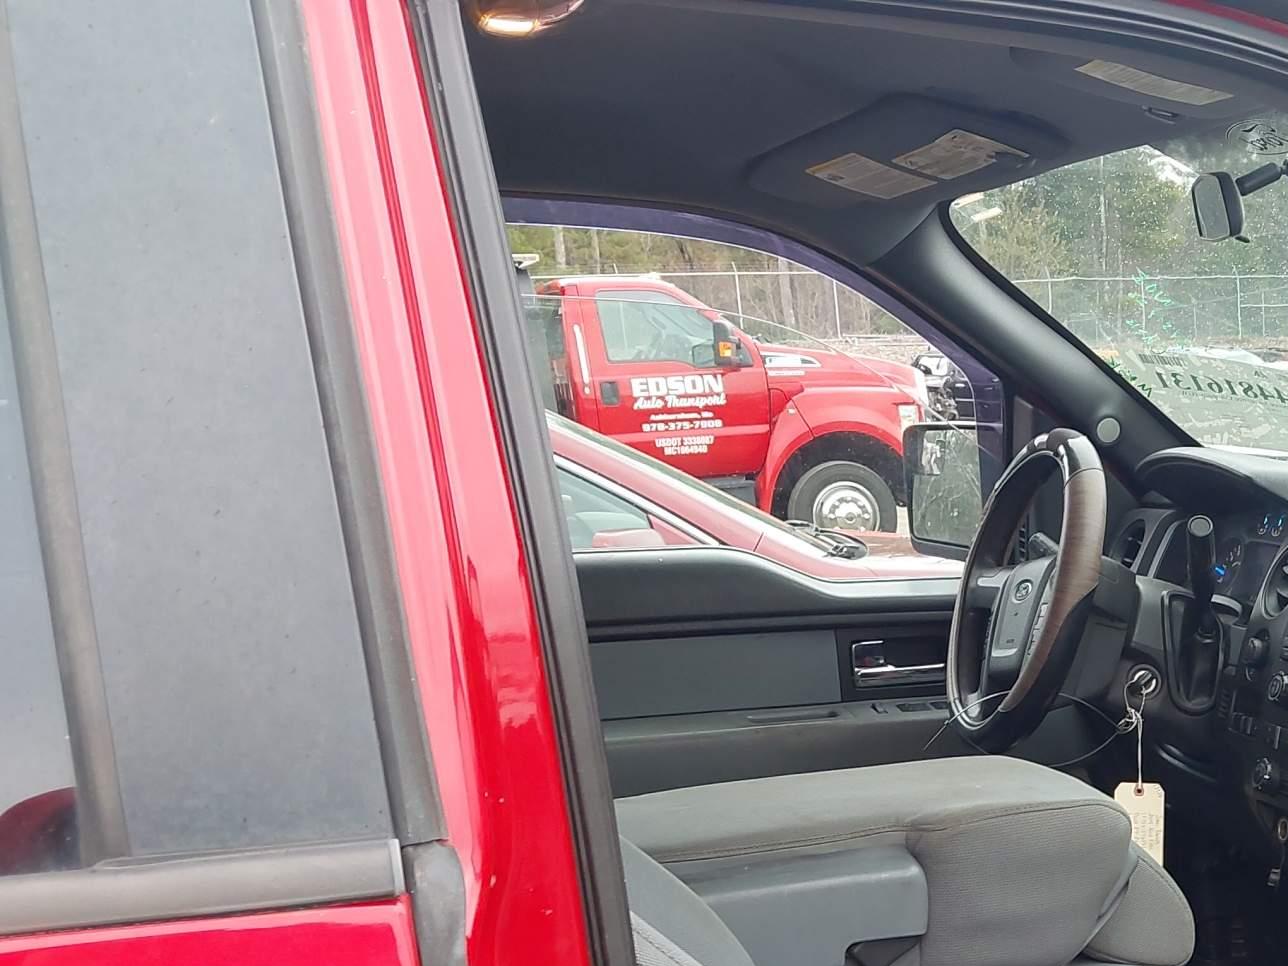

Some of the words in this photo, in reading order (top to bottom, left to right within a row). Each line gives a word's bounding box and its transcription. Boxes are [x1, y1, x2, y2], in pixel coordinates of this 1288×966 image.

[631, 374, 724, 397] EDSON
[633, 397, 664, 410] Auto
[665, 393, 727, 408] Transport
[656, 437, 682, 447] USDOT
